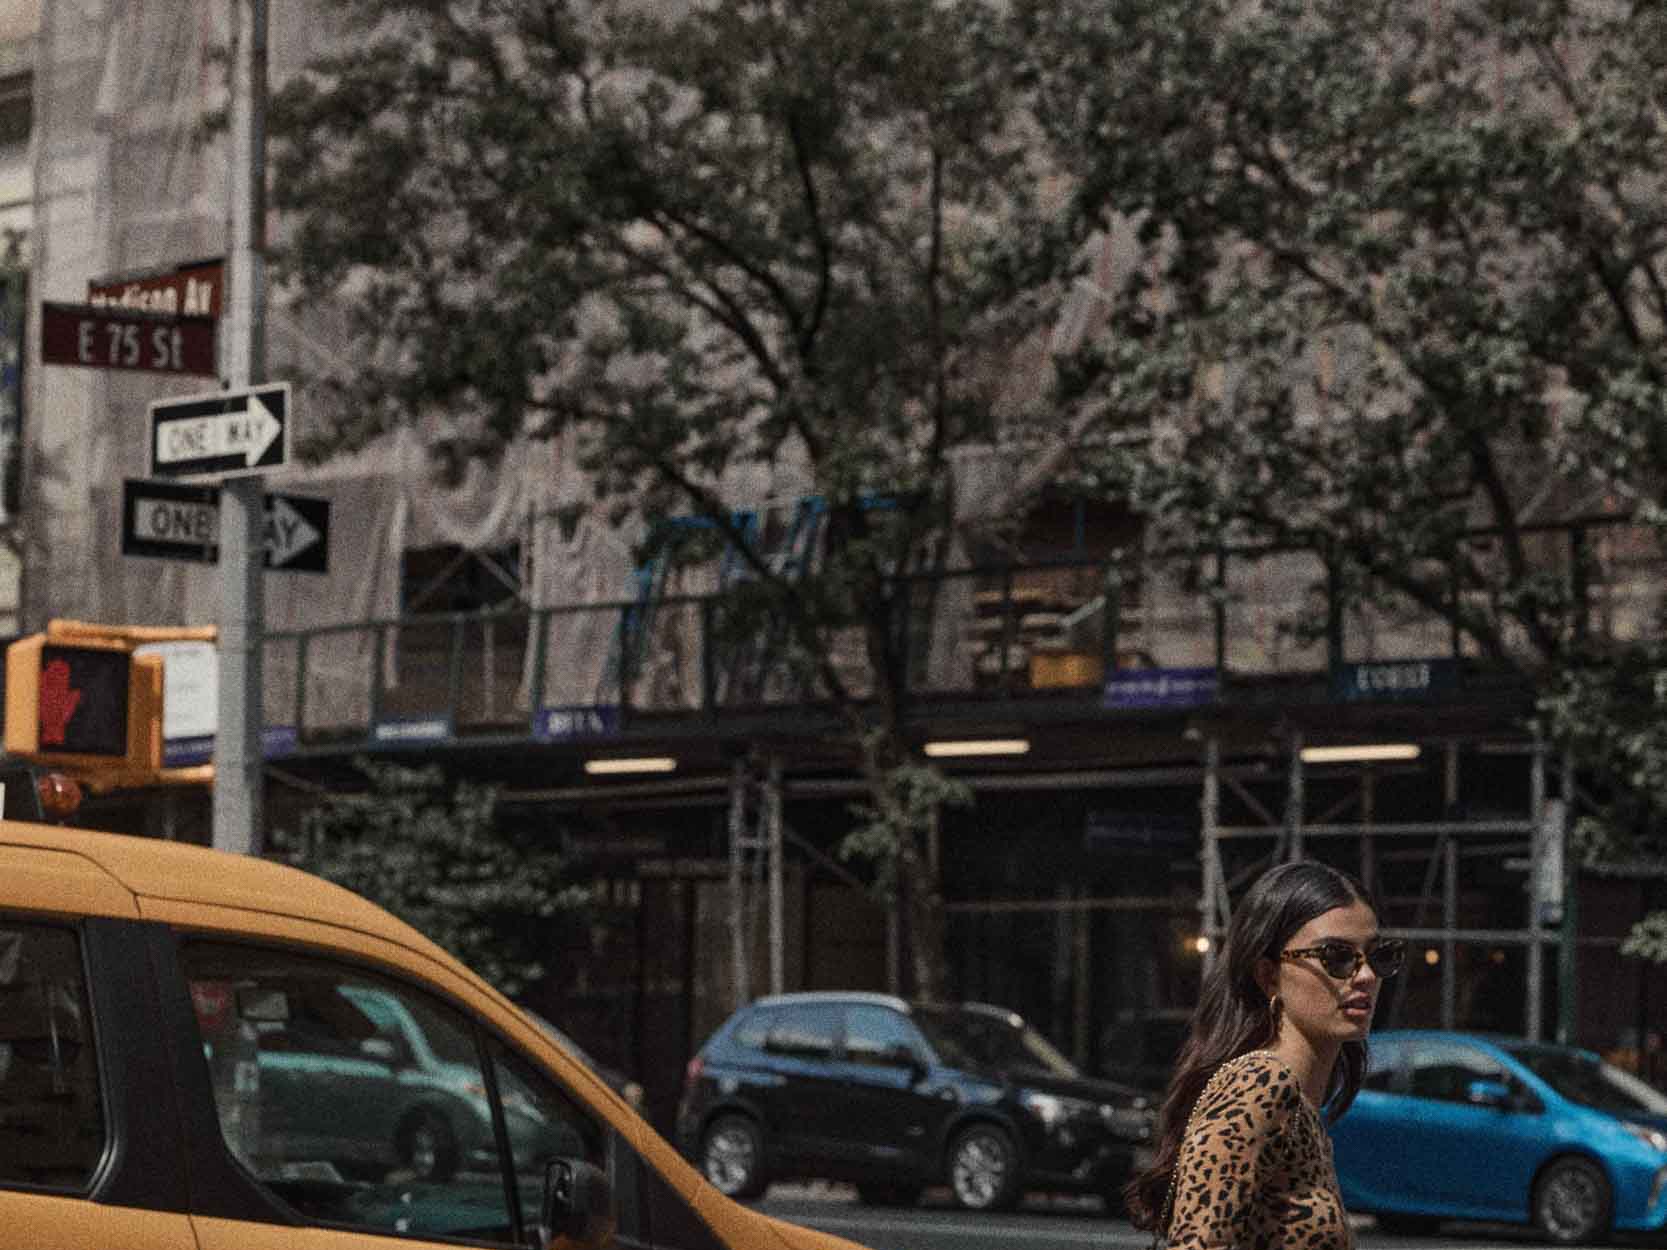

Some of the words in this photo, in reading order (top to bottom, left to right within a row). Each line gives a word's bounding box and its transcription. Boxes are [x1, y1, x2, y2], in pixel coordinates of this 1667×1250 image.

[79, 321, 96, 363] E
[106, 323, 140, 366] 75
[152, 327, 183, 369] St
[168, 422, 207, 455] ONE
[227, 418, 266, 444] WAY
[150, 503, 209, 540] ONE
